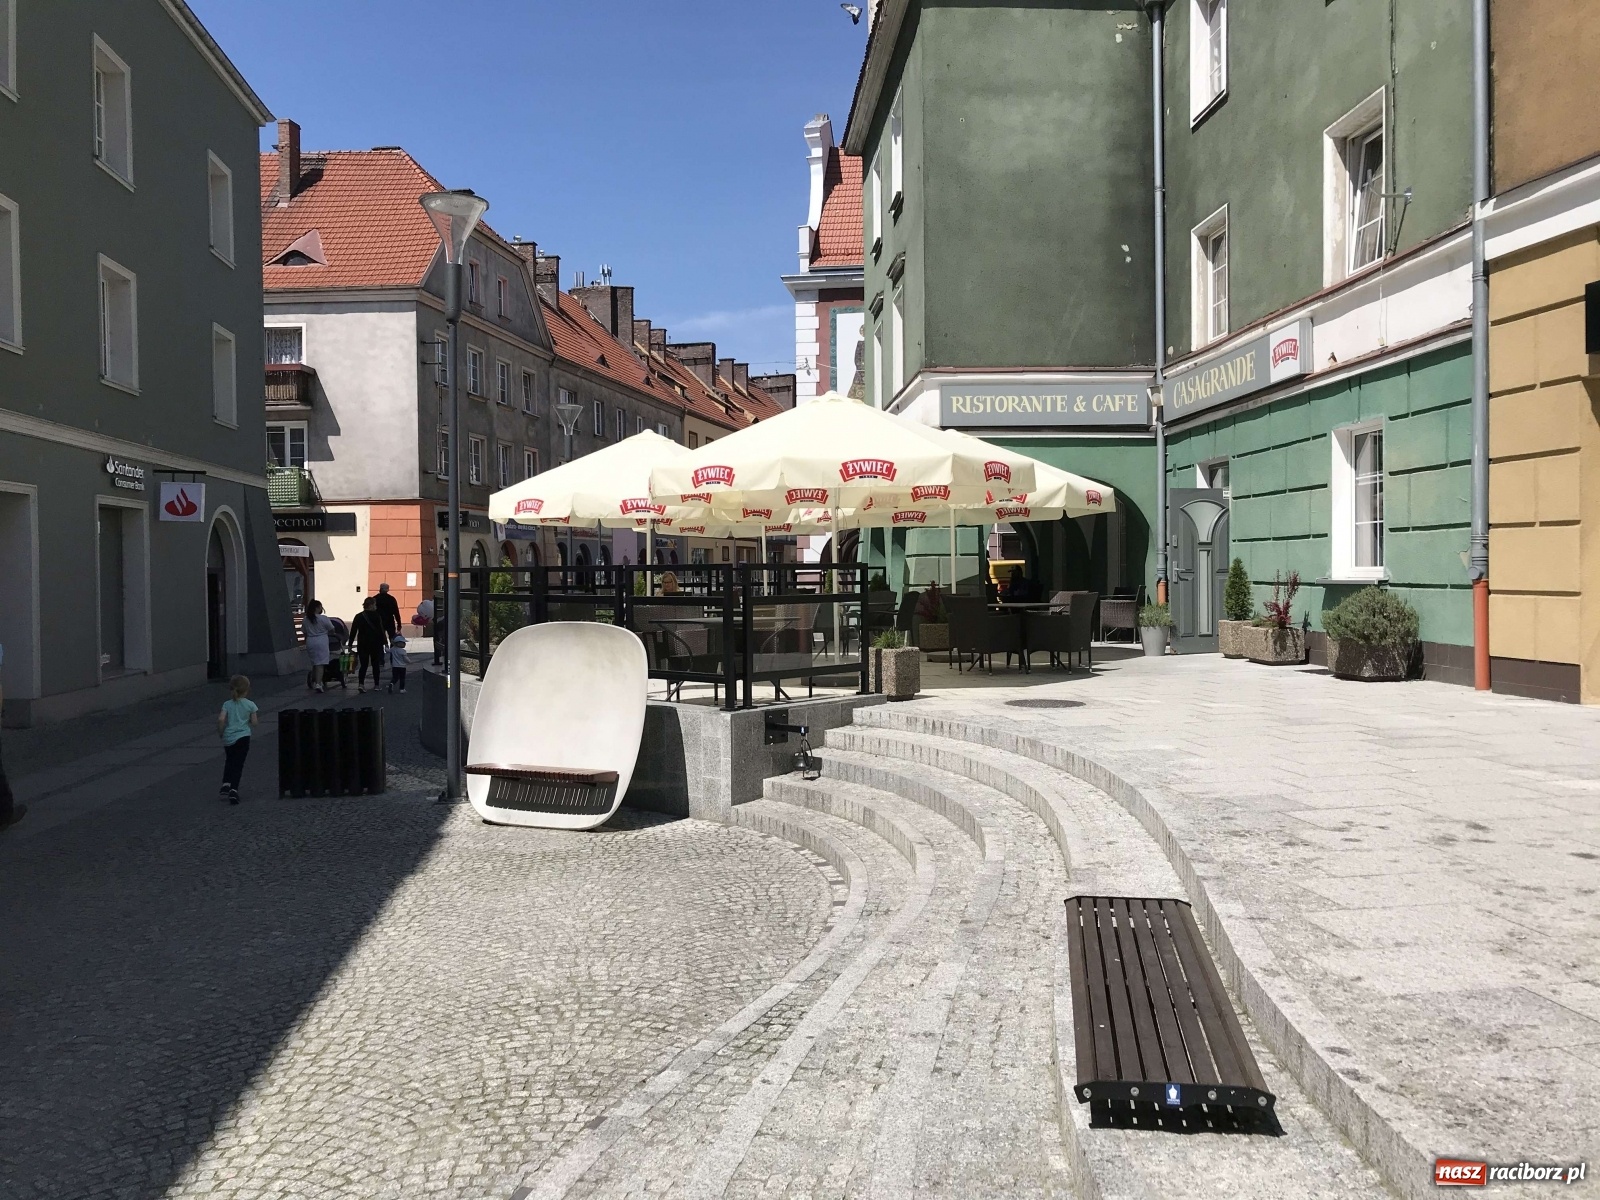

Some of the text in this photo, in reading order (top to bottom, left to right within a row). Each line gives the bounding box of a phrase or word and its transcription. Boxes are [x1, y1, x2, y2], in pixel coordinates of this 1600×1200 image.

[1173, 349, 1256, 409] CASAGRANDE
[951, 393, 1139, 414] RISTORANTE & CAFE
[114, 460, 145, 479] Santander
[698, 467, 730, 480] ŻYWIEC
[846, 460, 891, 475] ŻYWIEC
